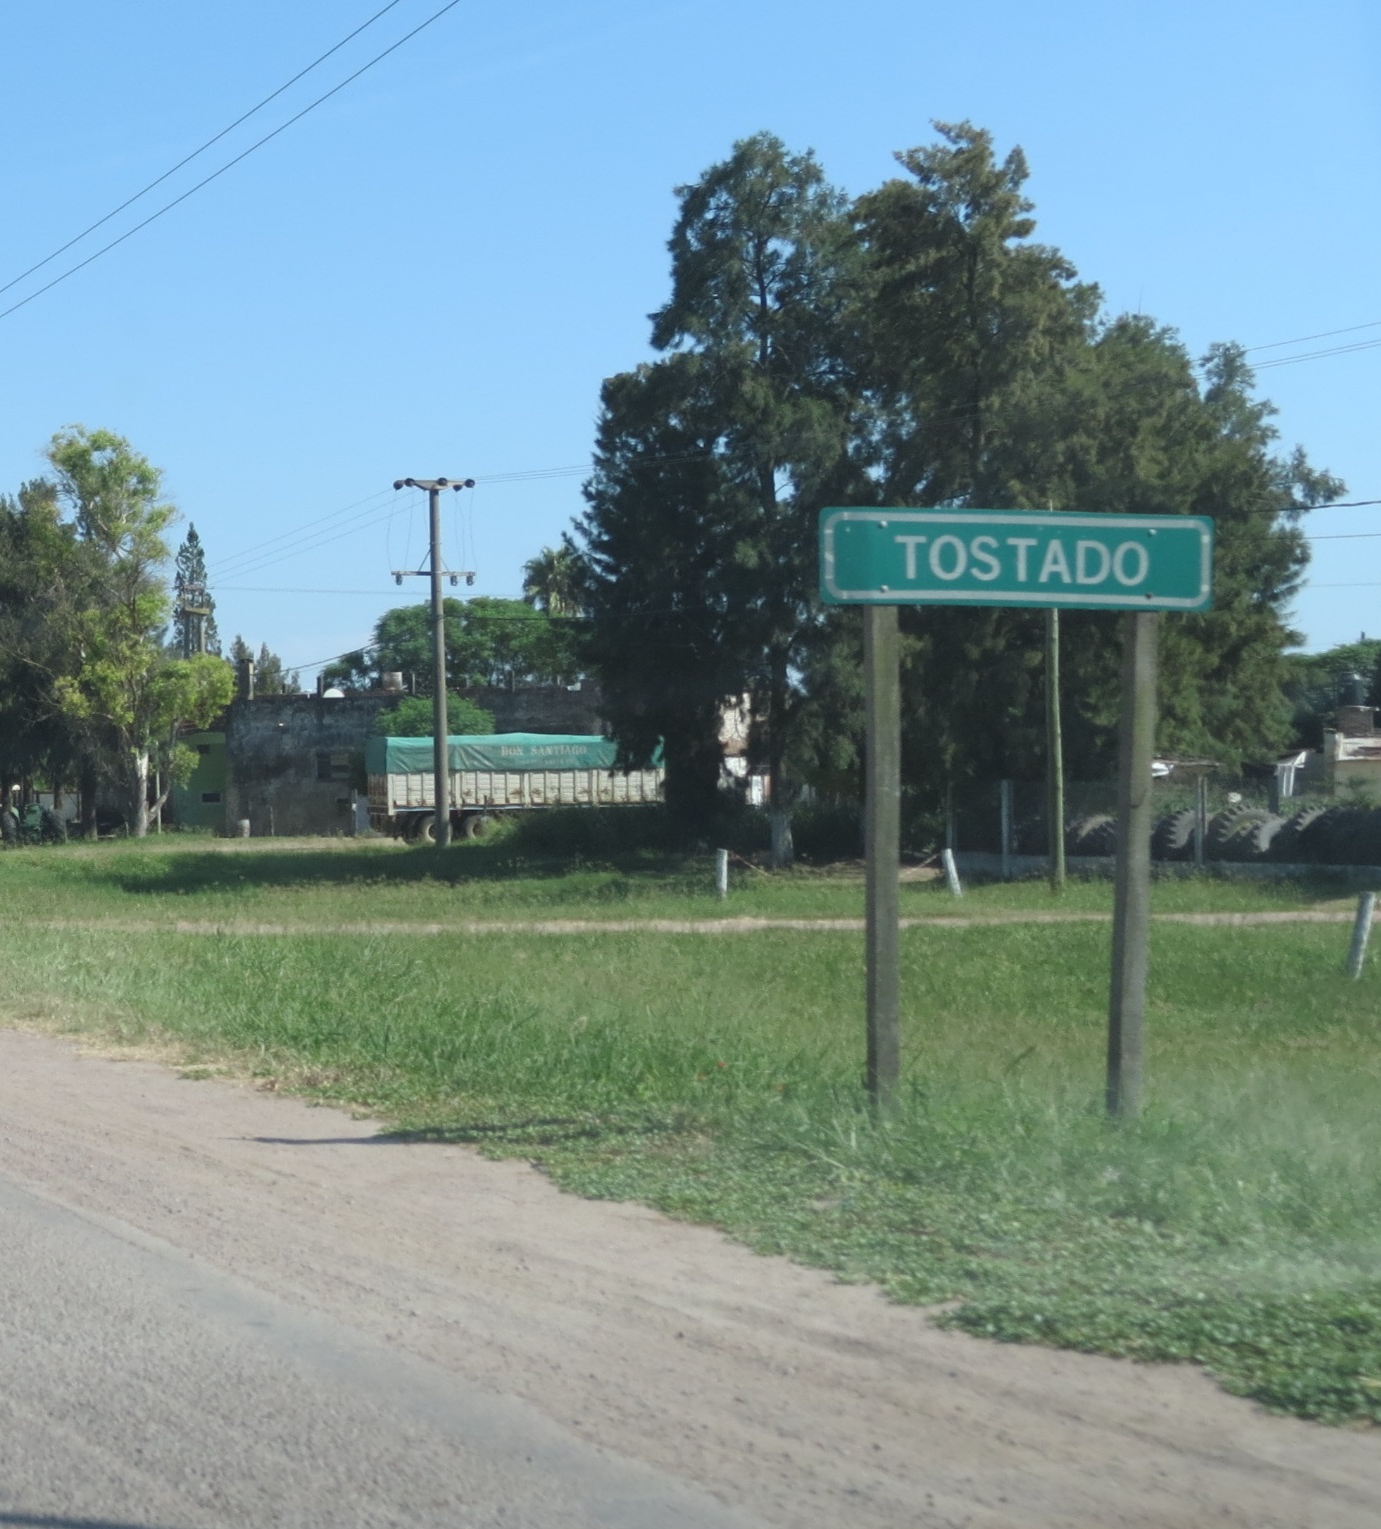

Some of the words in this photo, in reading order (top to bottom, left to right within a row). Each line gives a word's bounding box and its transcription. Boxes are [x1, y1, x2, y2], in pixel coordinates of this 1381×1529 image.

[894, 534, 1150, 587] TOSTADO
[500, 745, 524, 756] DON
[530, 744, 588, 756] SANTIAGO
